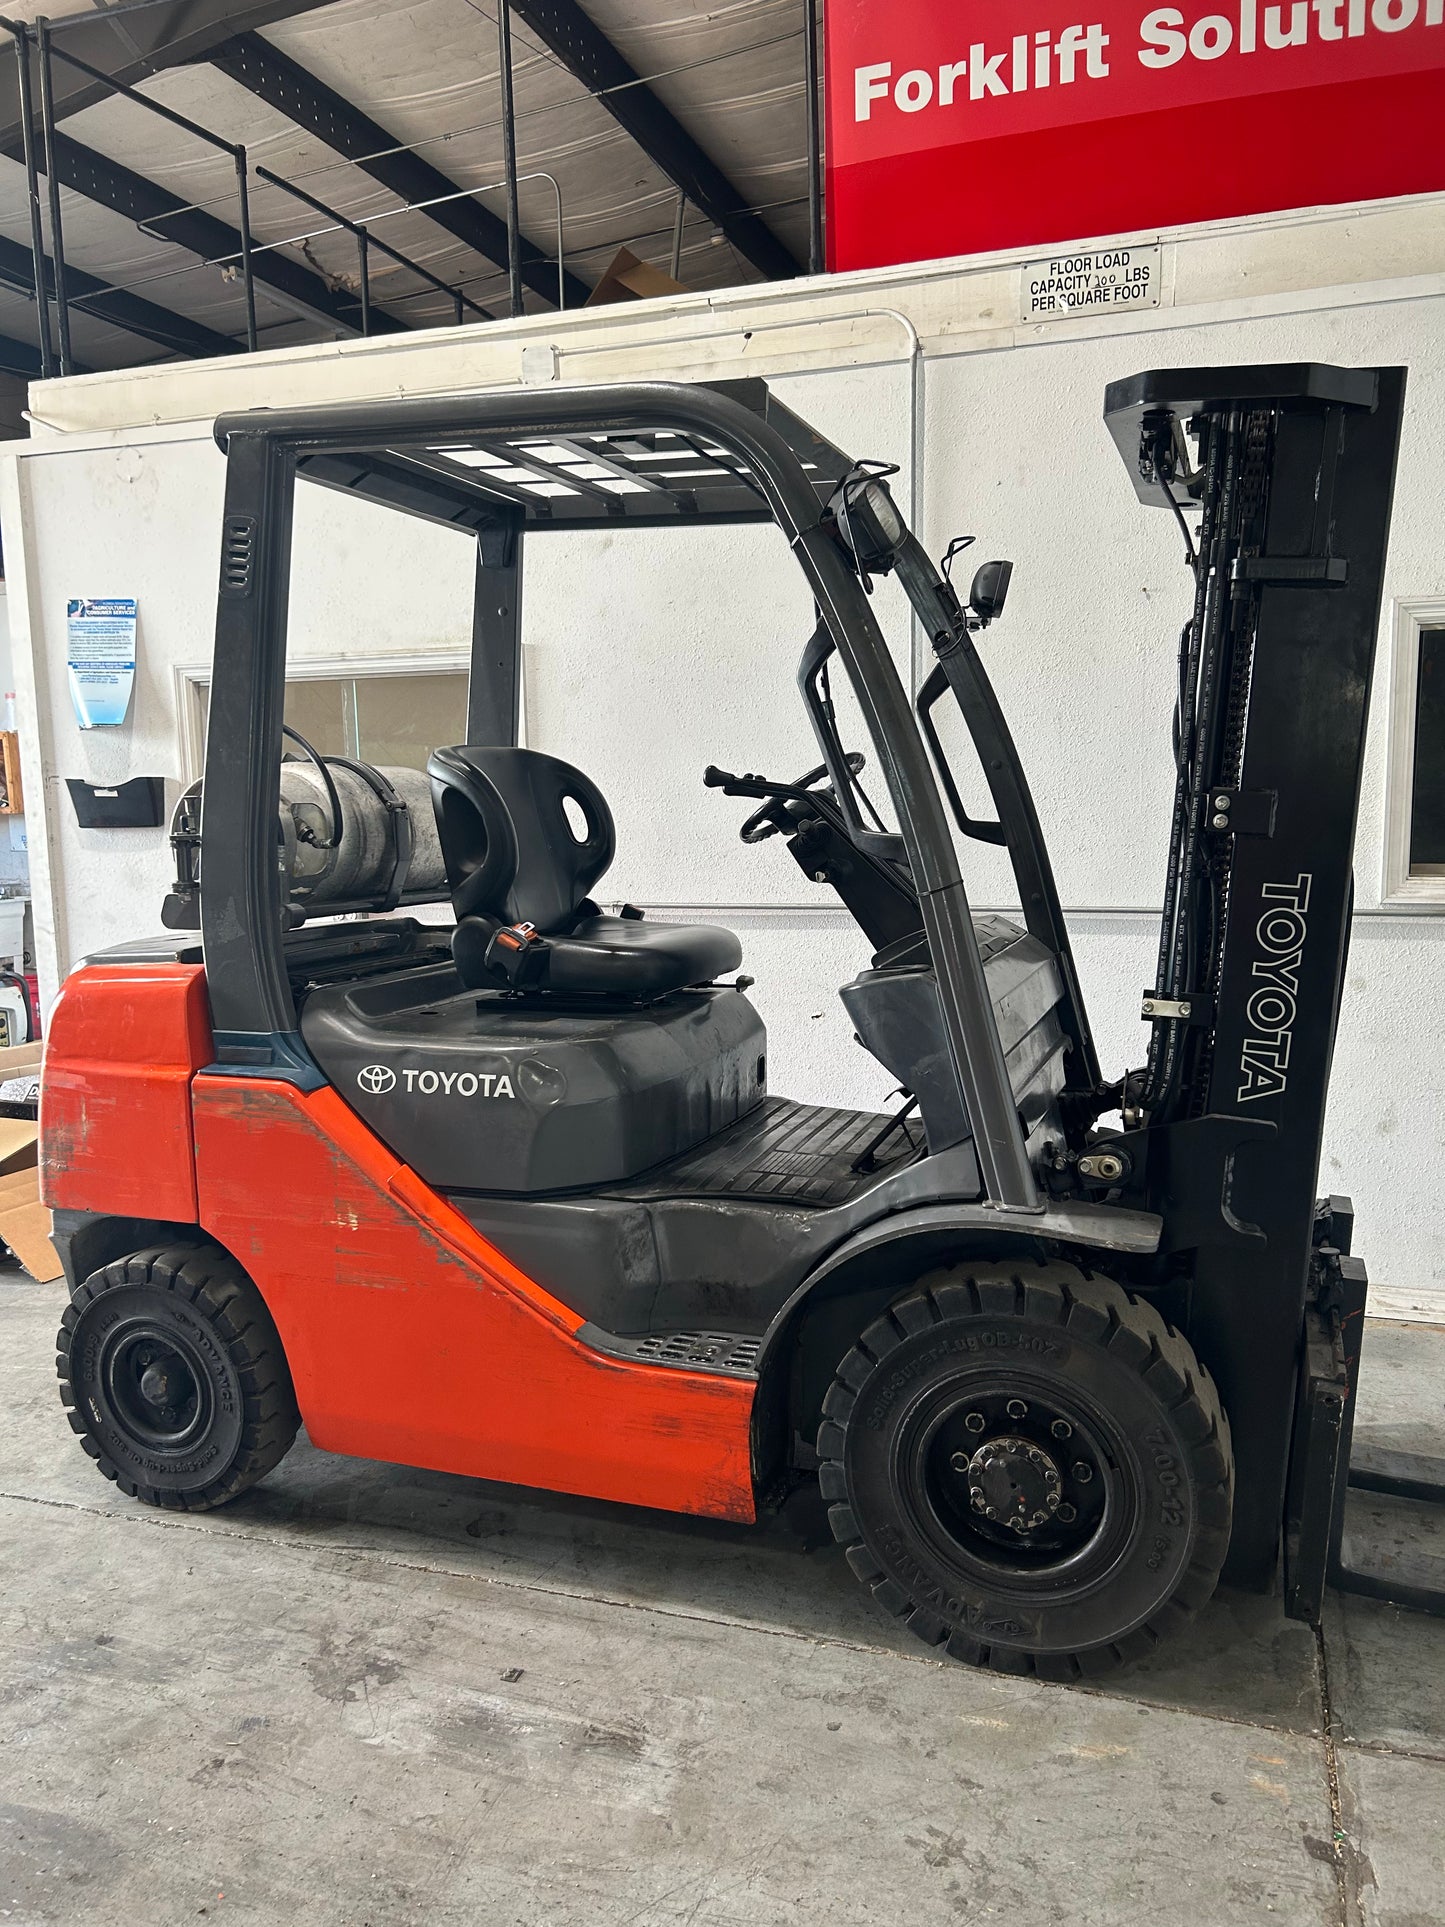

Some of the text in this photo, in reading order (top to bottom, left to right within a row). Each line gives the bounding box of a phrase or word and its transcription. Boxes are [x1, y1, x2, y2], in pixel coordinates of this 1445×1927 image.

[854, 24, 1109, 122] Forklift
[1050, 251, 1130, 276] FLOOR LOAD
[1030, 274, 1091, 295] CAPACITY
[1125, 266, 1150, 283] LBS
[1031, 283, 1149, 312] PER SQUARE FOOT
[1237, 872, 1313, 1103] TOYOTA
[402, 1069, 516, 1099] TOYOTA
